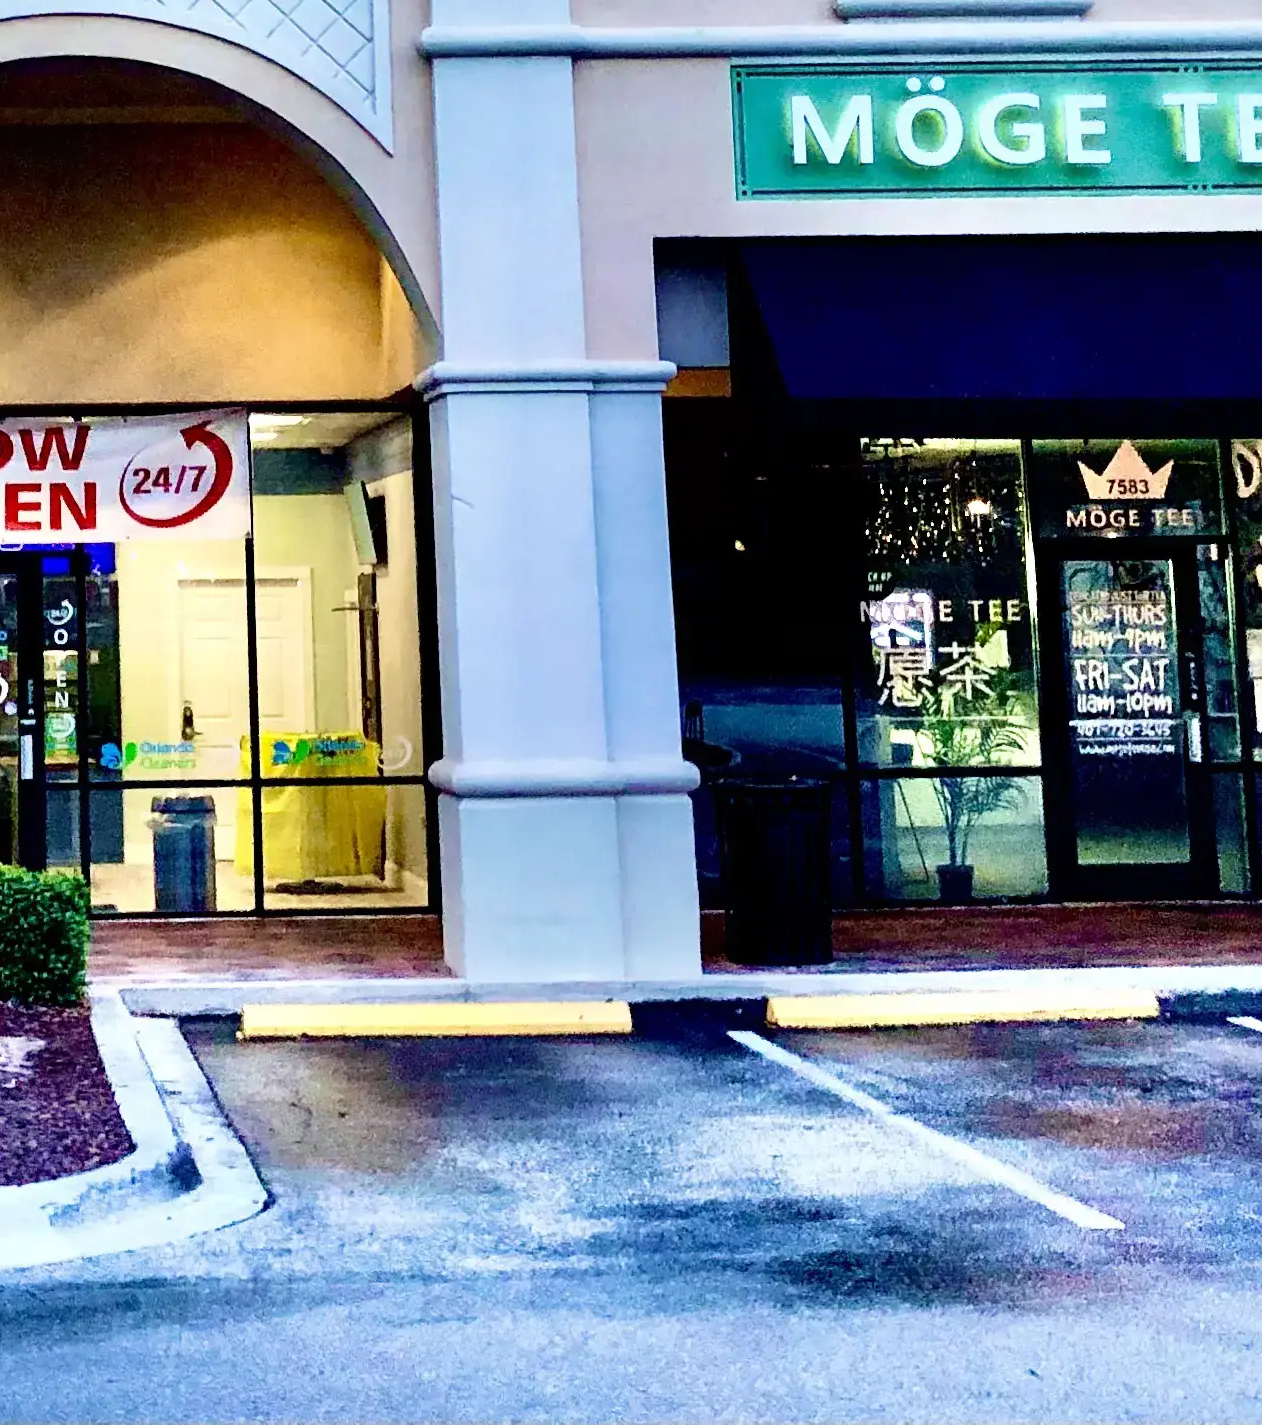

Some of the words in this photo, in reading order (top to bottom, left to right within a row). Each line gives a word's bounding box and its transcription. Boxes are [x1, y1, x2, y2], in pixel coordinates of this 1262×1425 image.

[790, 76, 1112, 167] MÖGE
[132, 465, 207, 495] 24/7
[1106, 479, 1150, 495] 7583
[1152, 508, 1196, 527] TEE
[967, 599, 1022, 623] TEE
[1074, 658, 1170, 691] FRI-SAT
[1076, 691, 1173, 718] 11am-10pm
